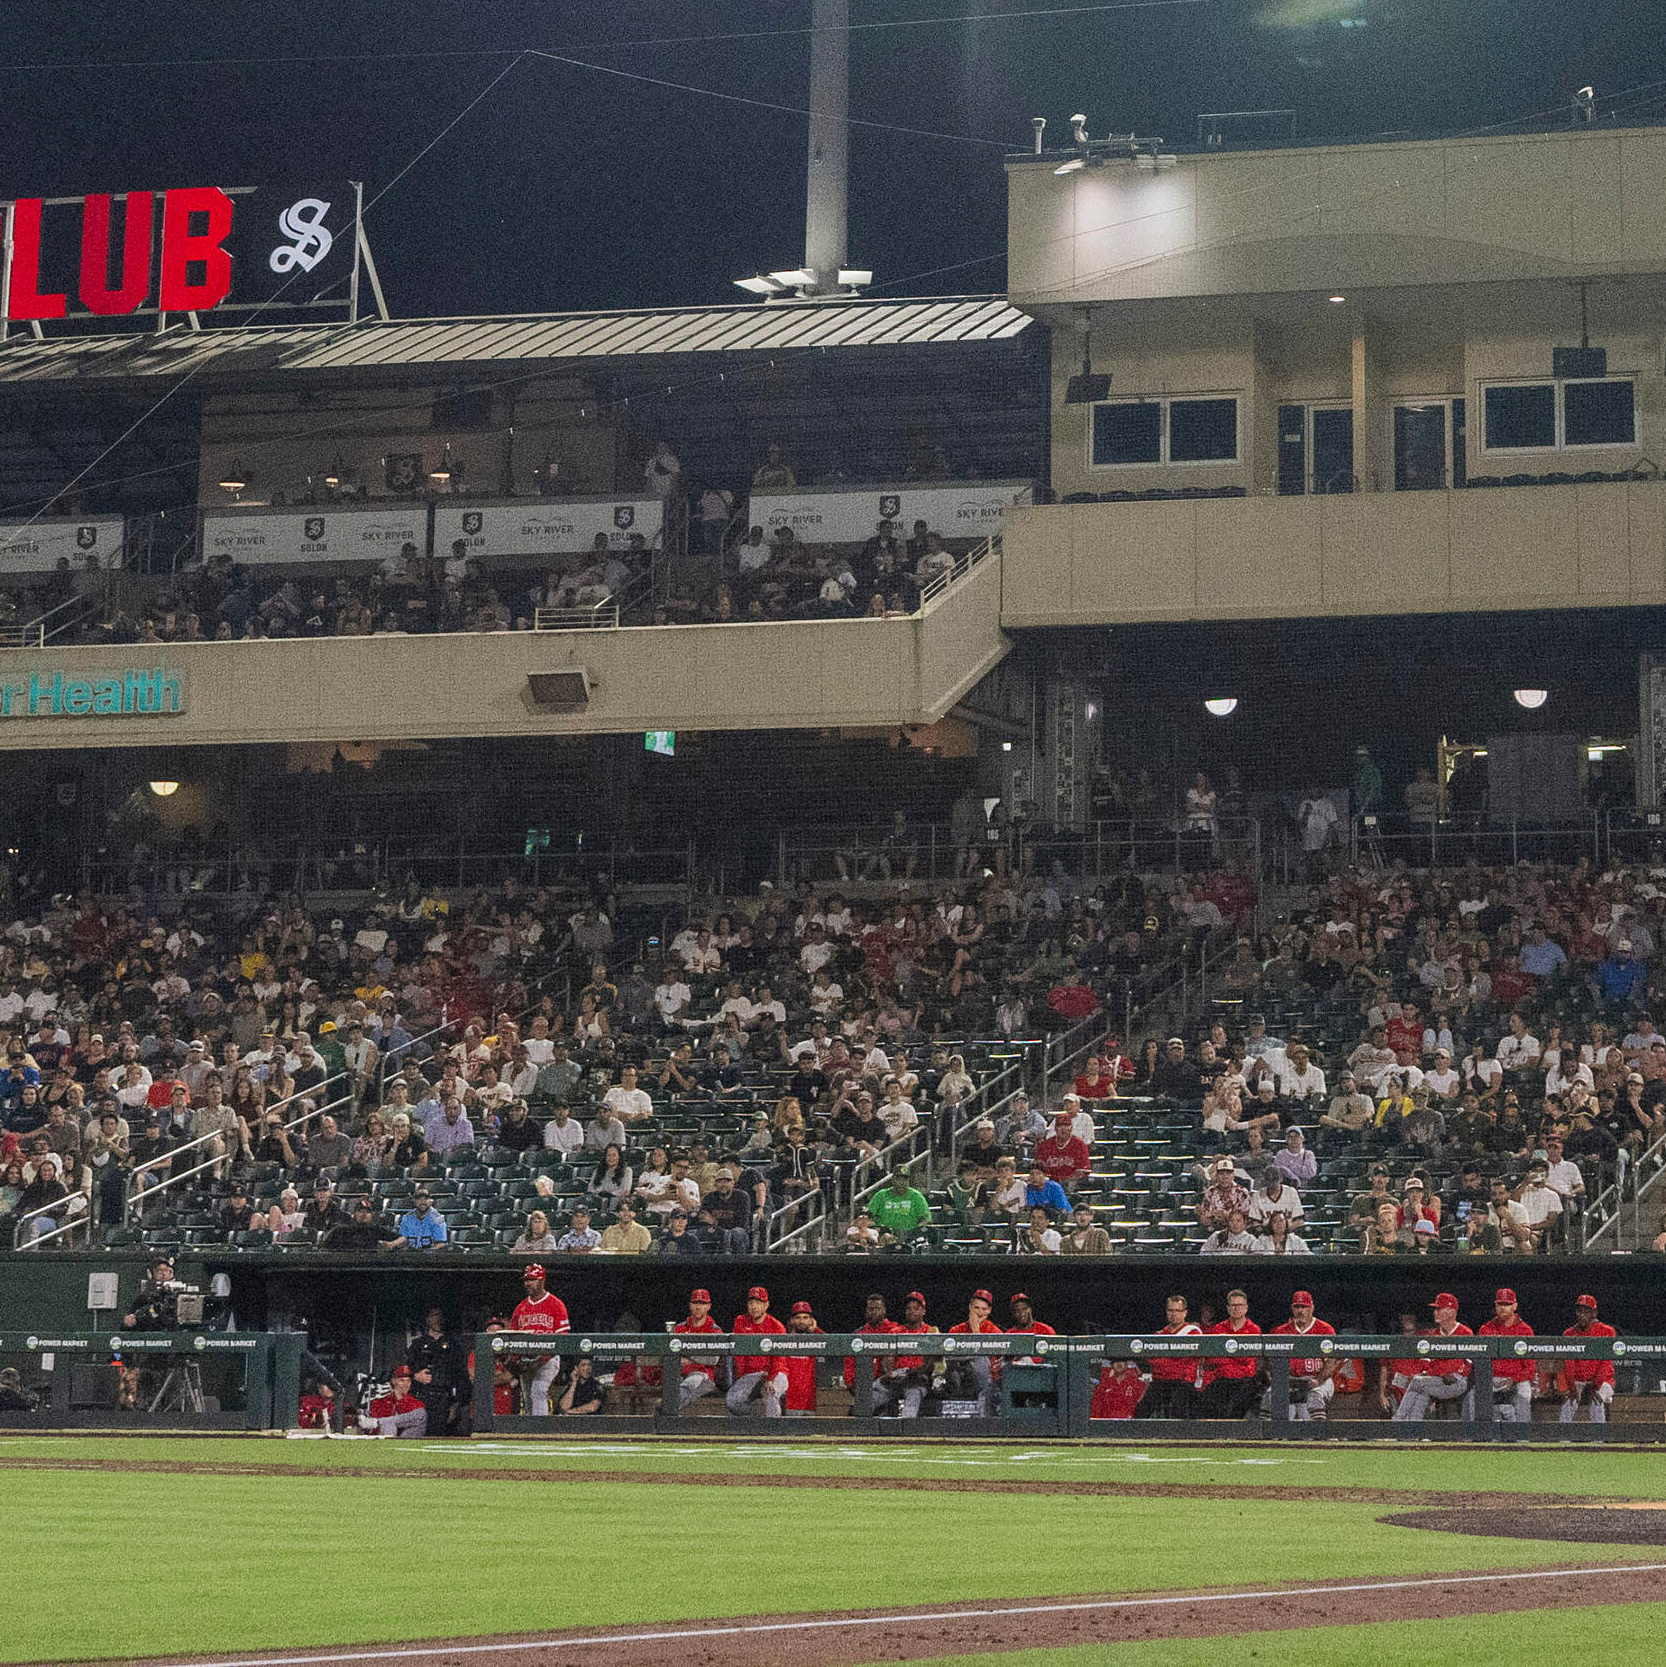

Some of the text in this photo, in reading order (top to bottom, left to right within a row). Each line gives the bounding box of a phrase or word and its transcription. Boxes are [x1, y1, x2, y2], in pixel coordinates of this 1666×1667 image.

[980, 508, 1004, 517] RIVE
[29, 667, 181, 716] Health
[798, 1341, 827, 1349] MARKET
[982, 1341, 1011, 1349] MARKET
[1265, 1343, 1295, 1351] MARKET
[1334, 1343, 1391, 1351] POWER MARKET
[1430, 1344, 1488, 1352] POWER MARKET
